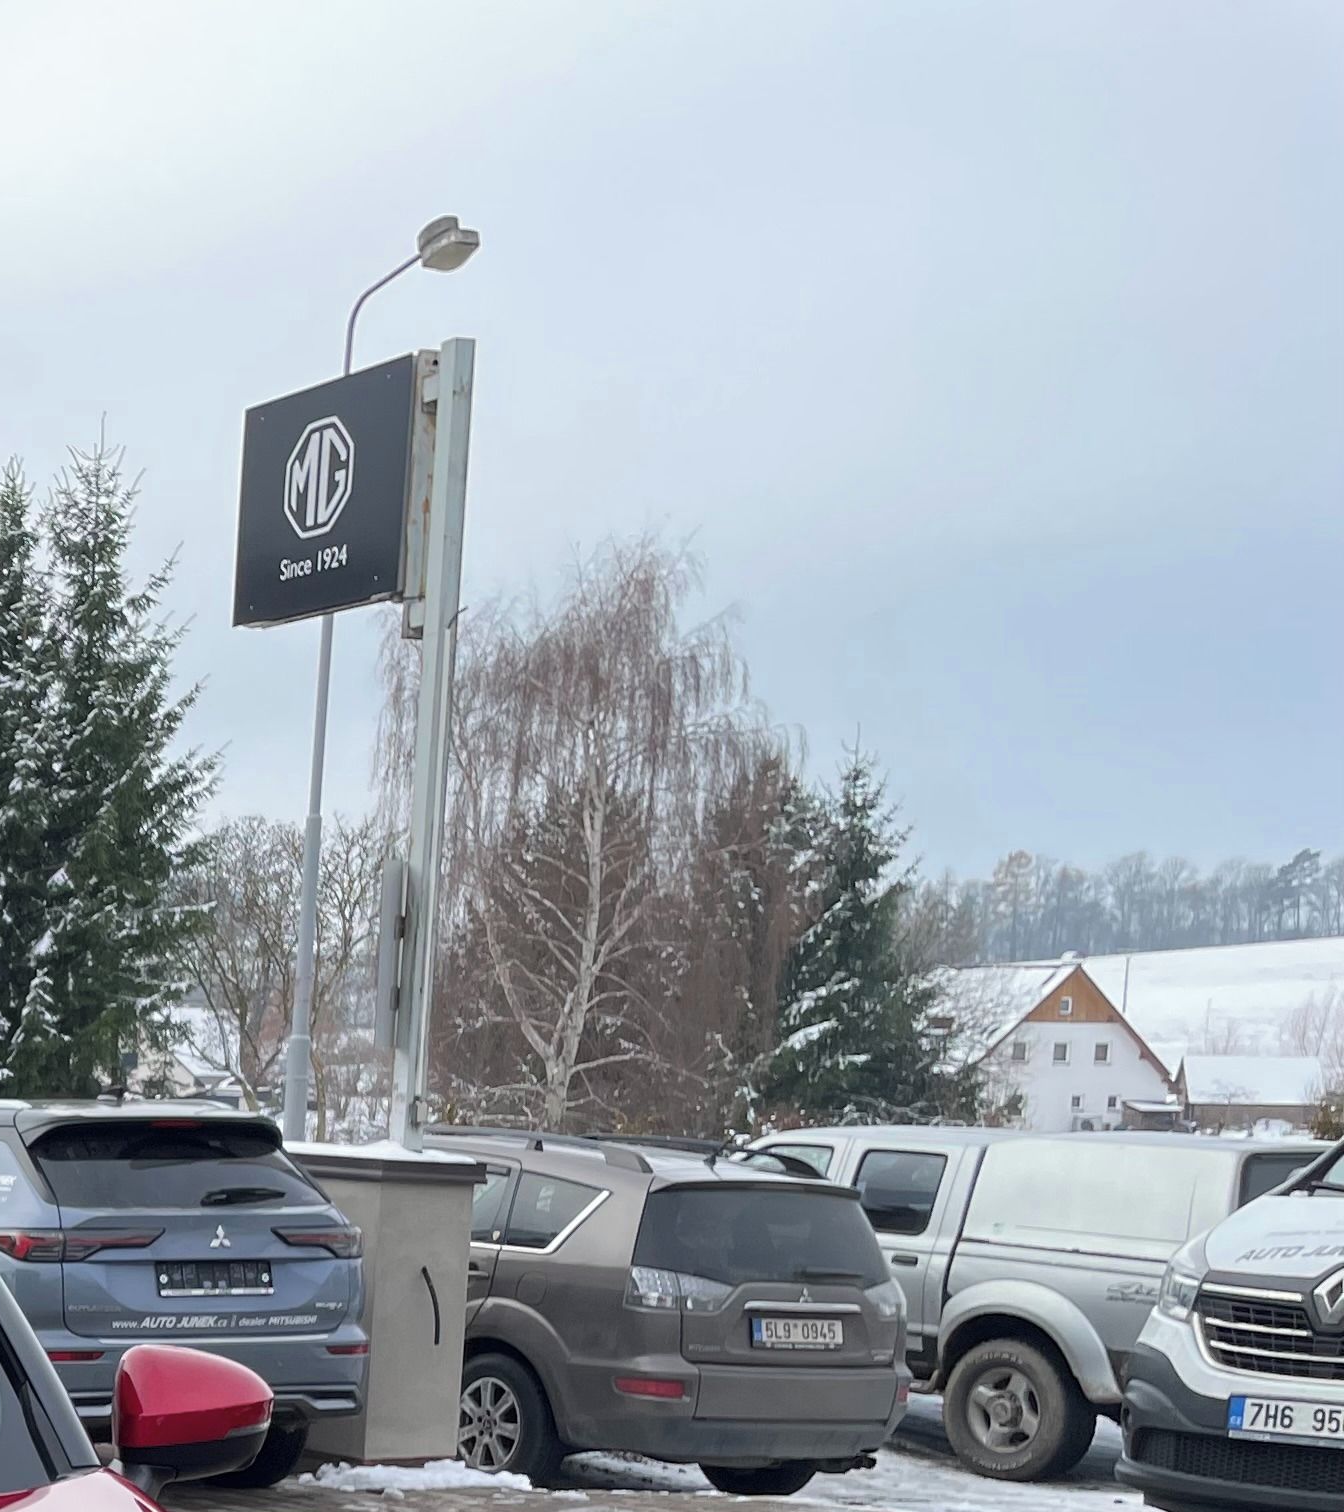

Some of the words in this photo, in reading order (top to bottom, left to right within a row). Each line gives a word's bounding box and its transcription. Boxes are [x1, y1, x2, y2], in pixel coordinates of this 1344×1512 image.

[290, 427, 349, 528] MG
[278, 556, 312, 582] Since
[316, 543, 348, 573] 1924
[1234, 1245, 1305, 1263] AUTO
[764, 1320, 792, 1339] 5L9
[801, 1321, 837, 1341] 0945
[1248, 1402, 1295, 1429] 7H6
[1311, 1407, 1344, 1434] 95
